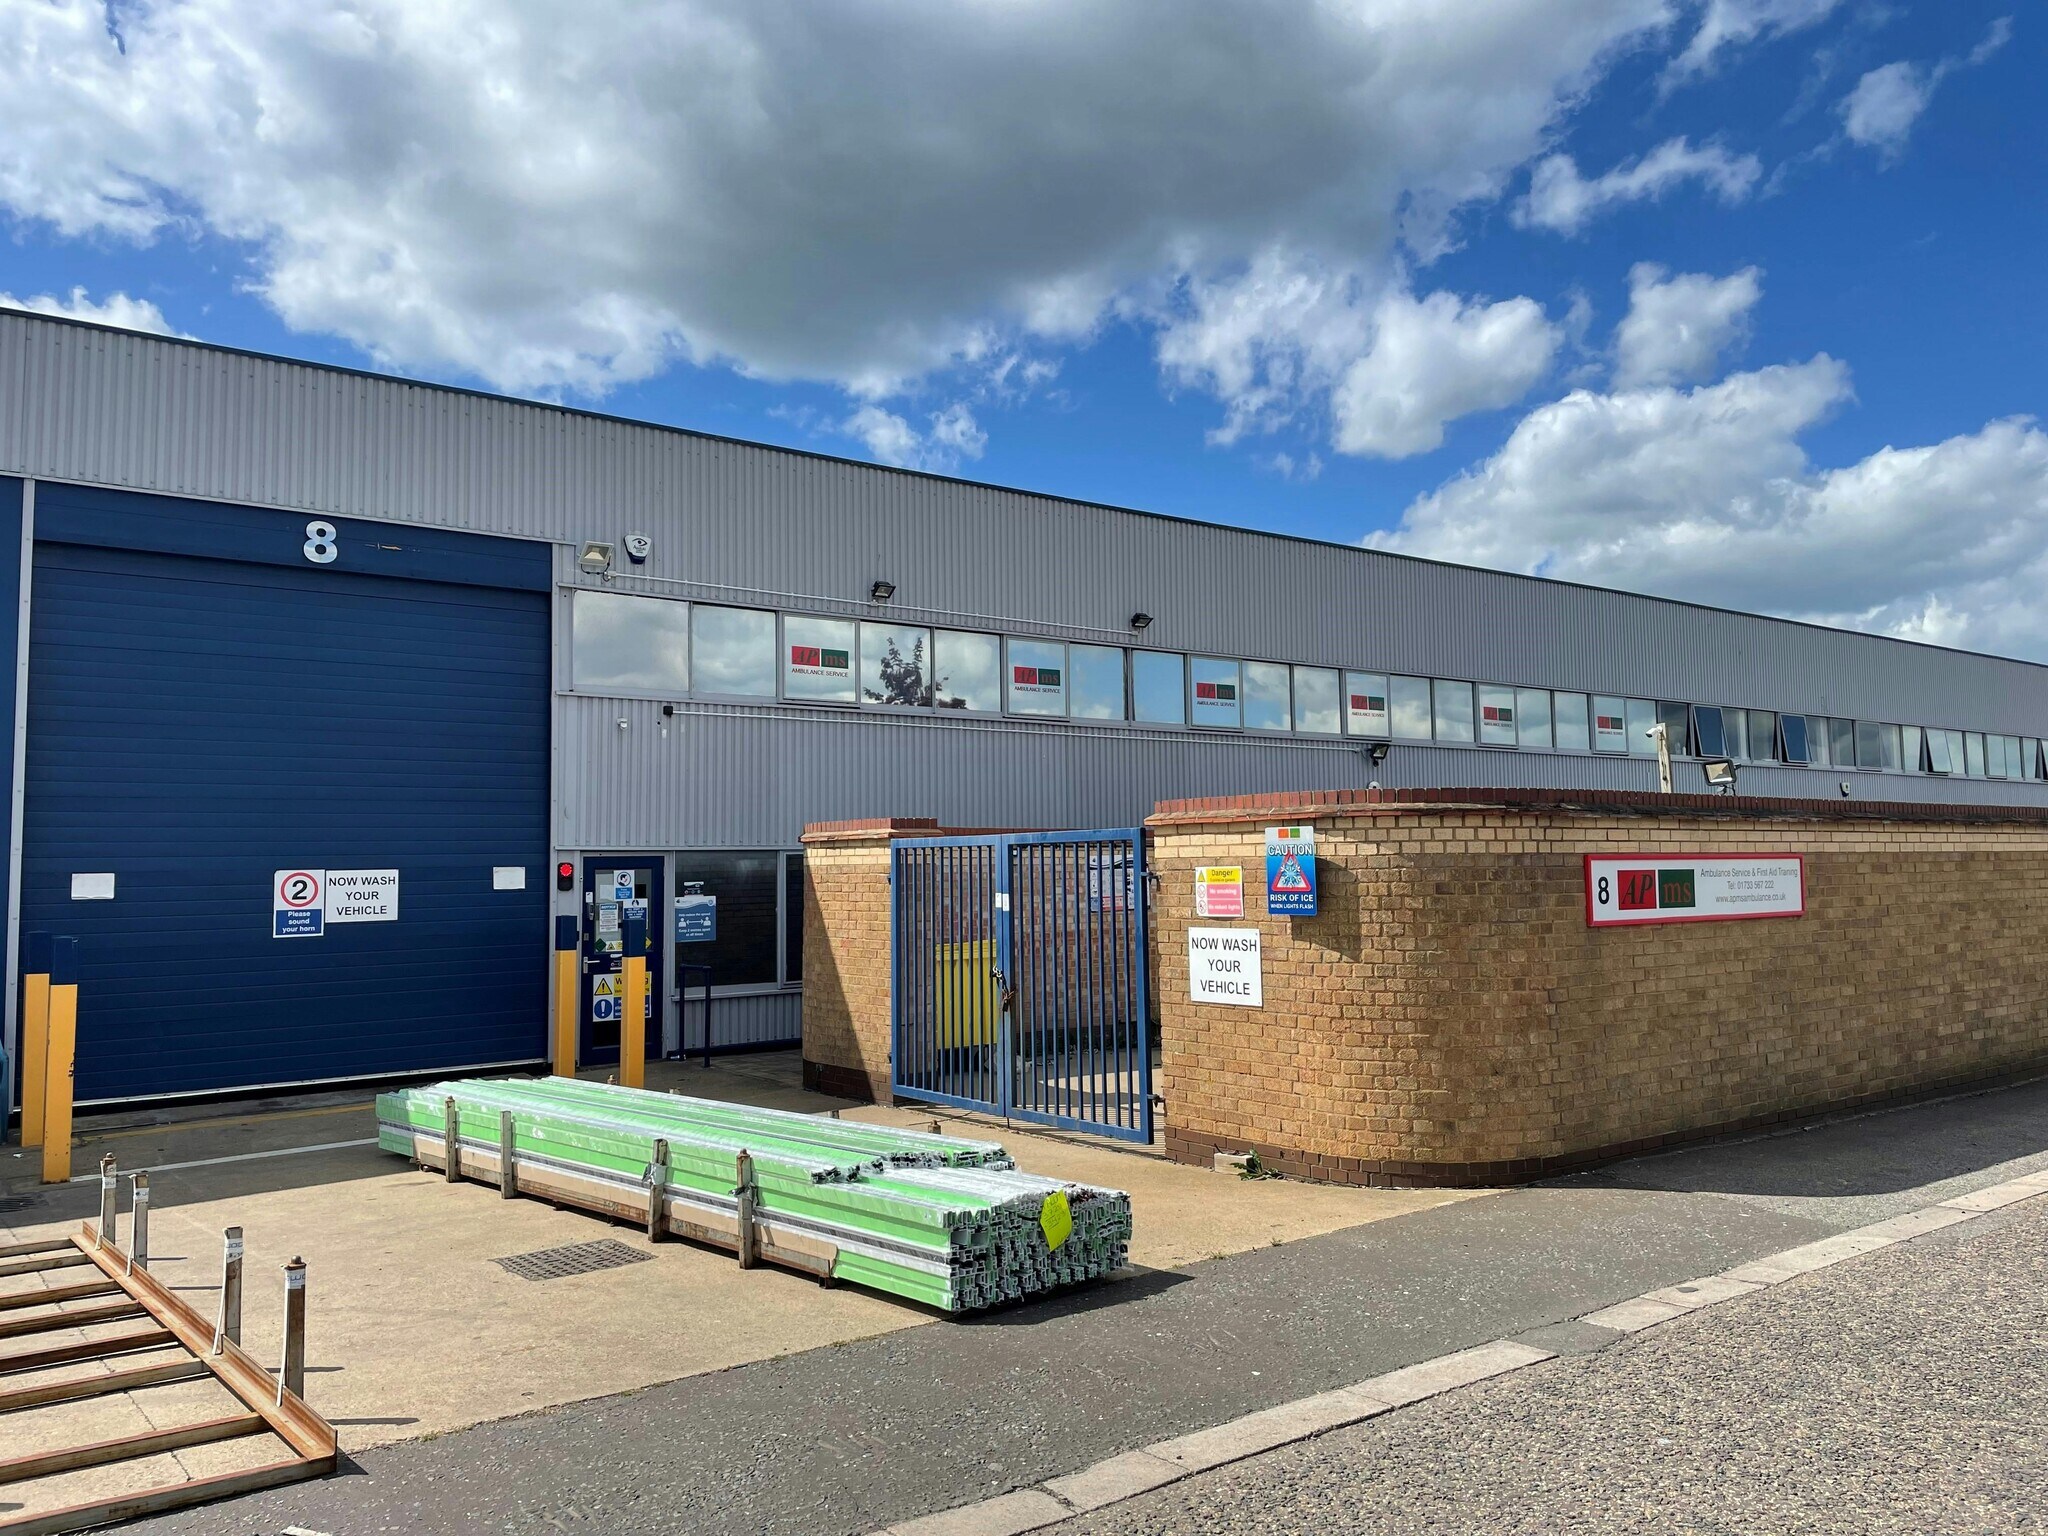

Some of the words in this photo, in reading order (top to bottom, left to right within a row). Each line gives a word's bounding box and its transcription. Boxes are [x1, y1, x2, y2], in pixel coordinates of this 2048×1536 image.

[303, 520, 338, 564] 8
[1268, 844, 1313, 856] CAUTION
[1700, 868, 1731, 877] Ambulance
[1731, 868, 1750, 877] Service
[1751, 868, 1756, 877] &
[1756, 868, 1768, 876] First
[1768, 867, 1778, 876] Aid
[1778, 867, 1798, 878] Training
[328, 877, 358, 887] NOW
[361, 876, 396, 886] WASH
[1737, 881, 1753, 890] 01733
[1764, 880, 1774, 889] 222
[292, 880, 307, 900] 2
[1598, 876, 1610, 905] 8
[1621, 873, 1654, 905] AP
[1663, 882, 1692, 903] ms
[345, 891, 379, 901] YOUR
[1270, 894, 1287, 902] RISK
[1289, 894, 1299, 902] OF
[1301, 894, 1314, 902] ICE
[1715, 892, 1786, 904] www.apmsambulance.co.uk
[336, 905, 387, 916] VEHICLE
[1191, 937, 1219, 951] NOW
[1222, 938, 1257, 952] WASH
[1207, 959, 1242, 973] YOUR
[1200, 979, 1250, 996] VEHICLE
